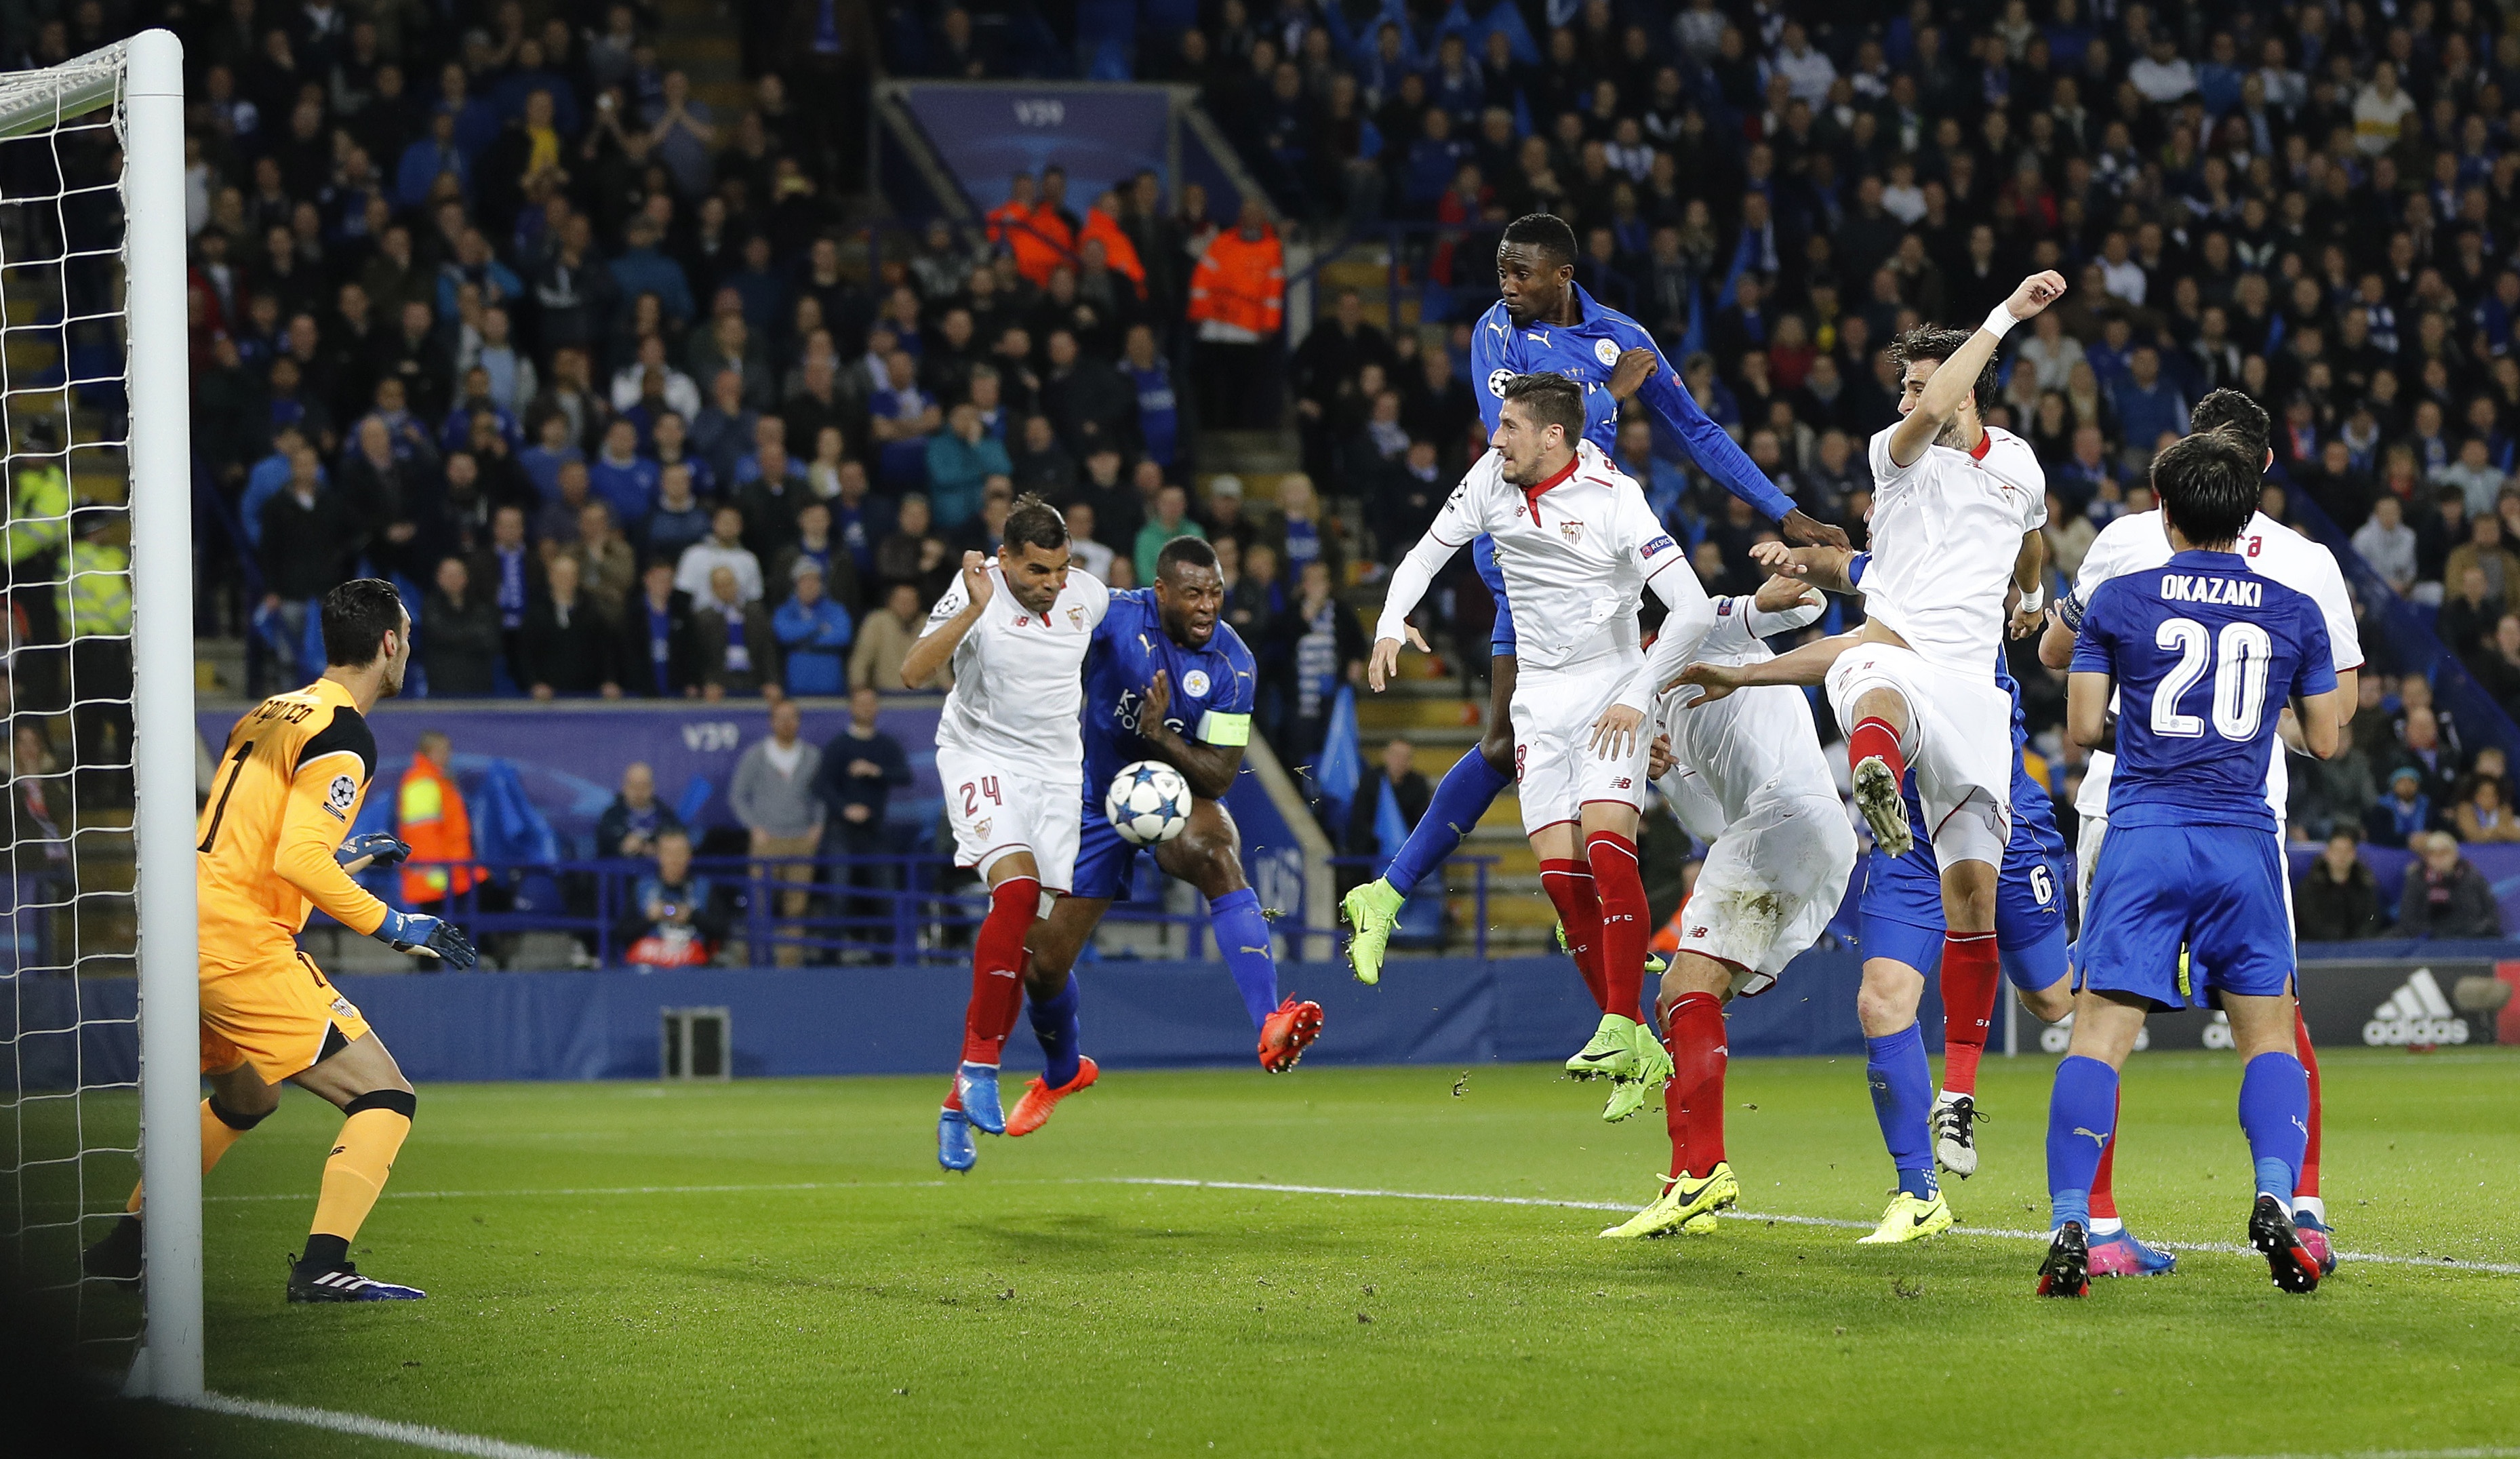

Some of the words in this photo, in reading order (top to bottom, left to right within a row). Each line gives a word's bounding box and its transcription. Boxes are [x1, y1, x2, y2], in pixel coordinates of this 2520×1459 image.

[2161, 574, 2262, 608] OKAZAKI
[2151, 618, 2273, 742] 20
[681, 721, 740, 752] V39
[197, 740, 254, 853] 1
[959, 776, 1003, 818] 24
[2030, 864, 2053, 905] 6
[1603, 915, 1633, 925] SFC
[2363, 1014, 2470, 1046] adidas
